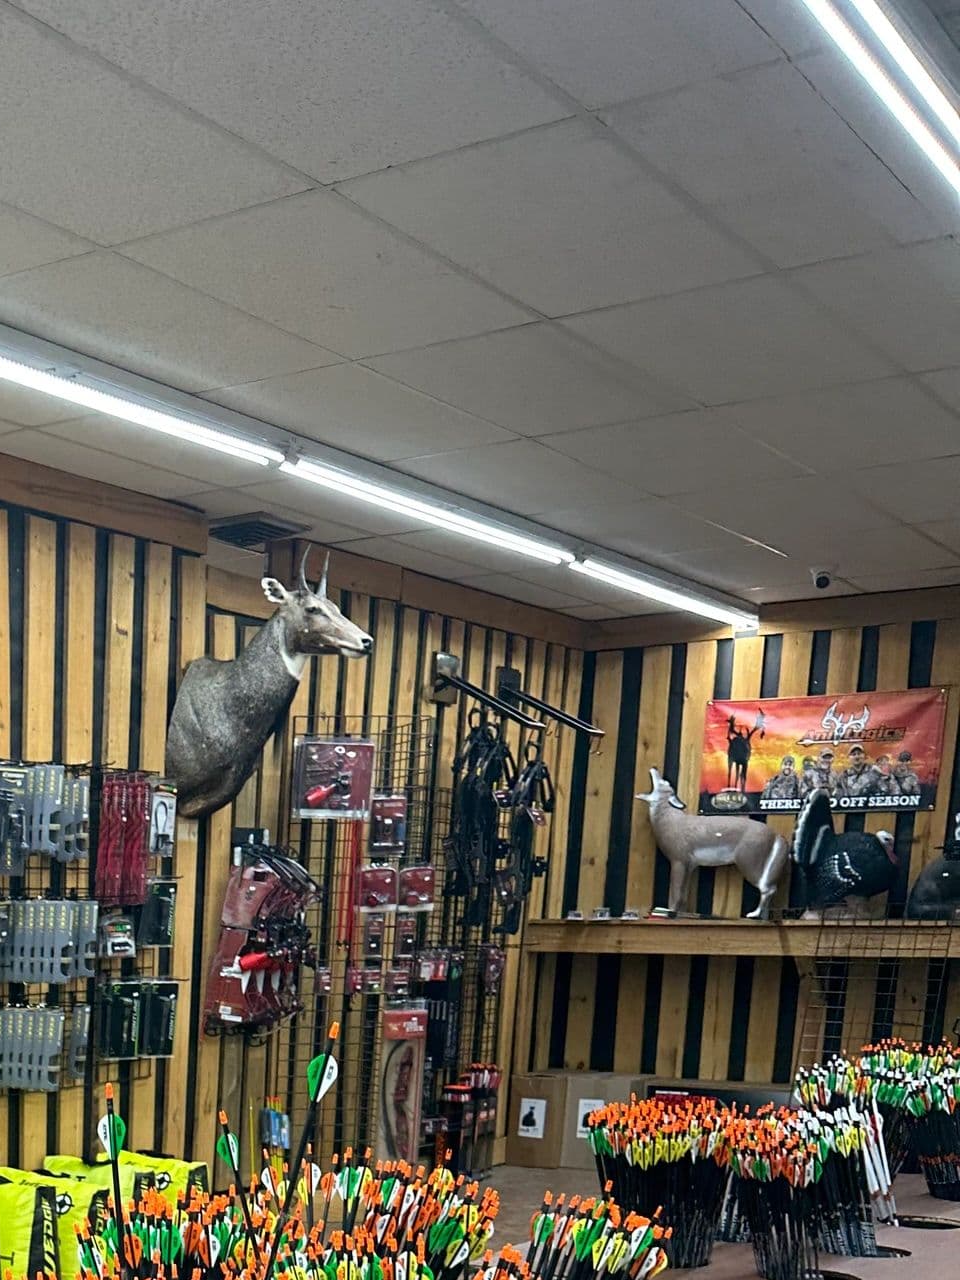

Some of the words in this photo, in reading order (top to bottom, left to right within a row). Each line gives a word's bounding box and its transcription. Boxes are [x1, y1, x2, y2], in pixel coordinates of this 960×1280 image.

[760, 799, 801, 810] THERE
[842, 796, 867, 808] OFF
[868, 794, 921, 807] SEASON
